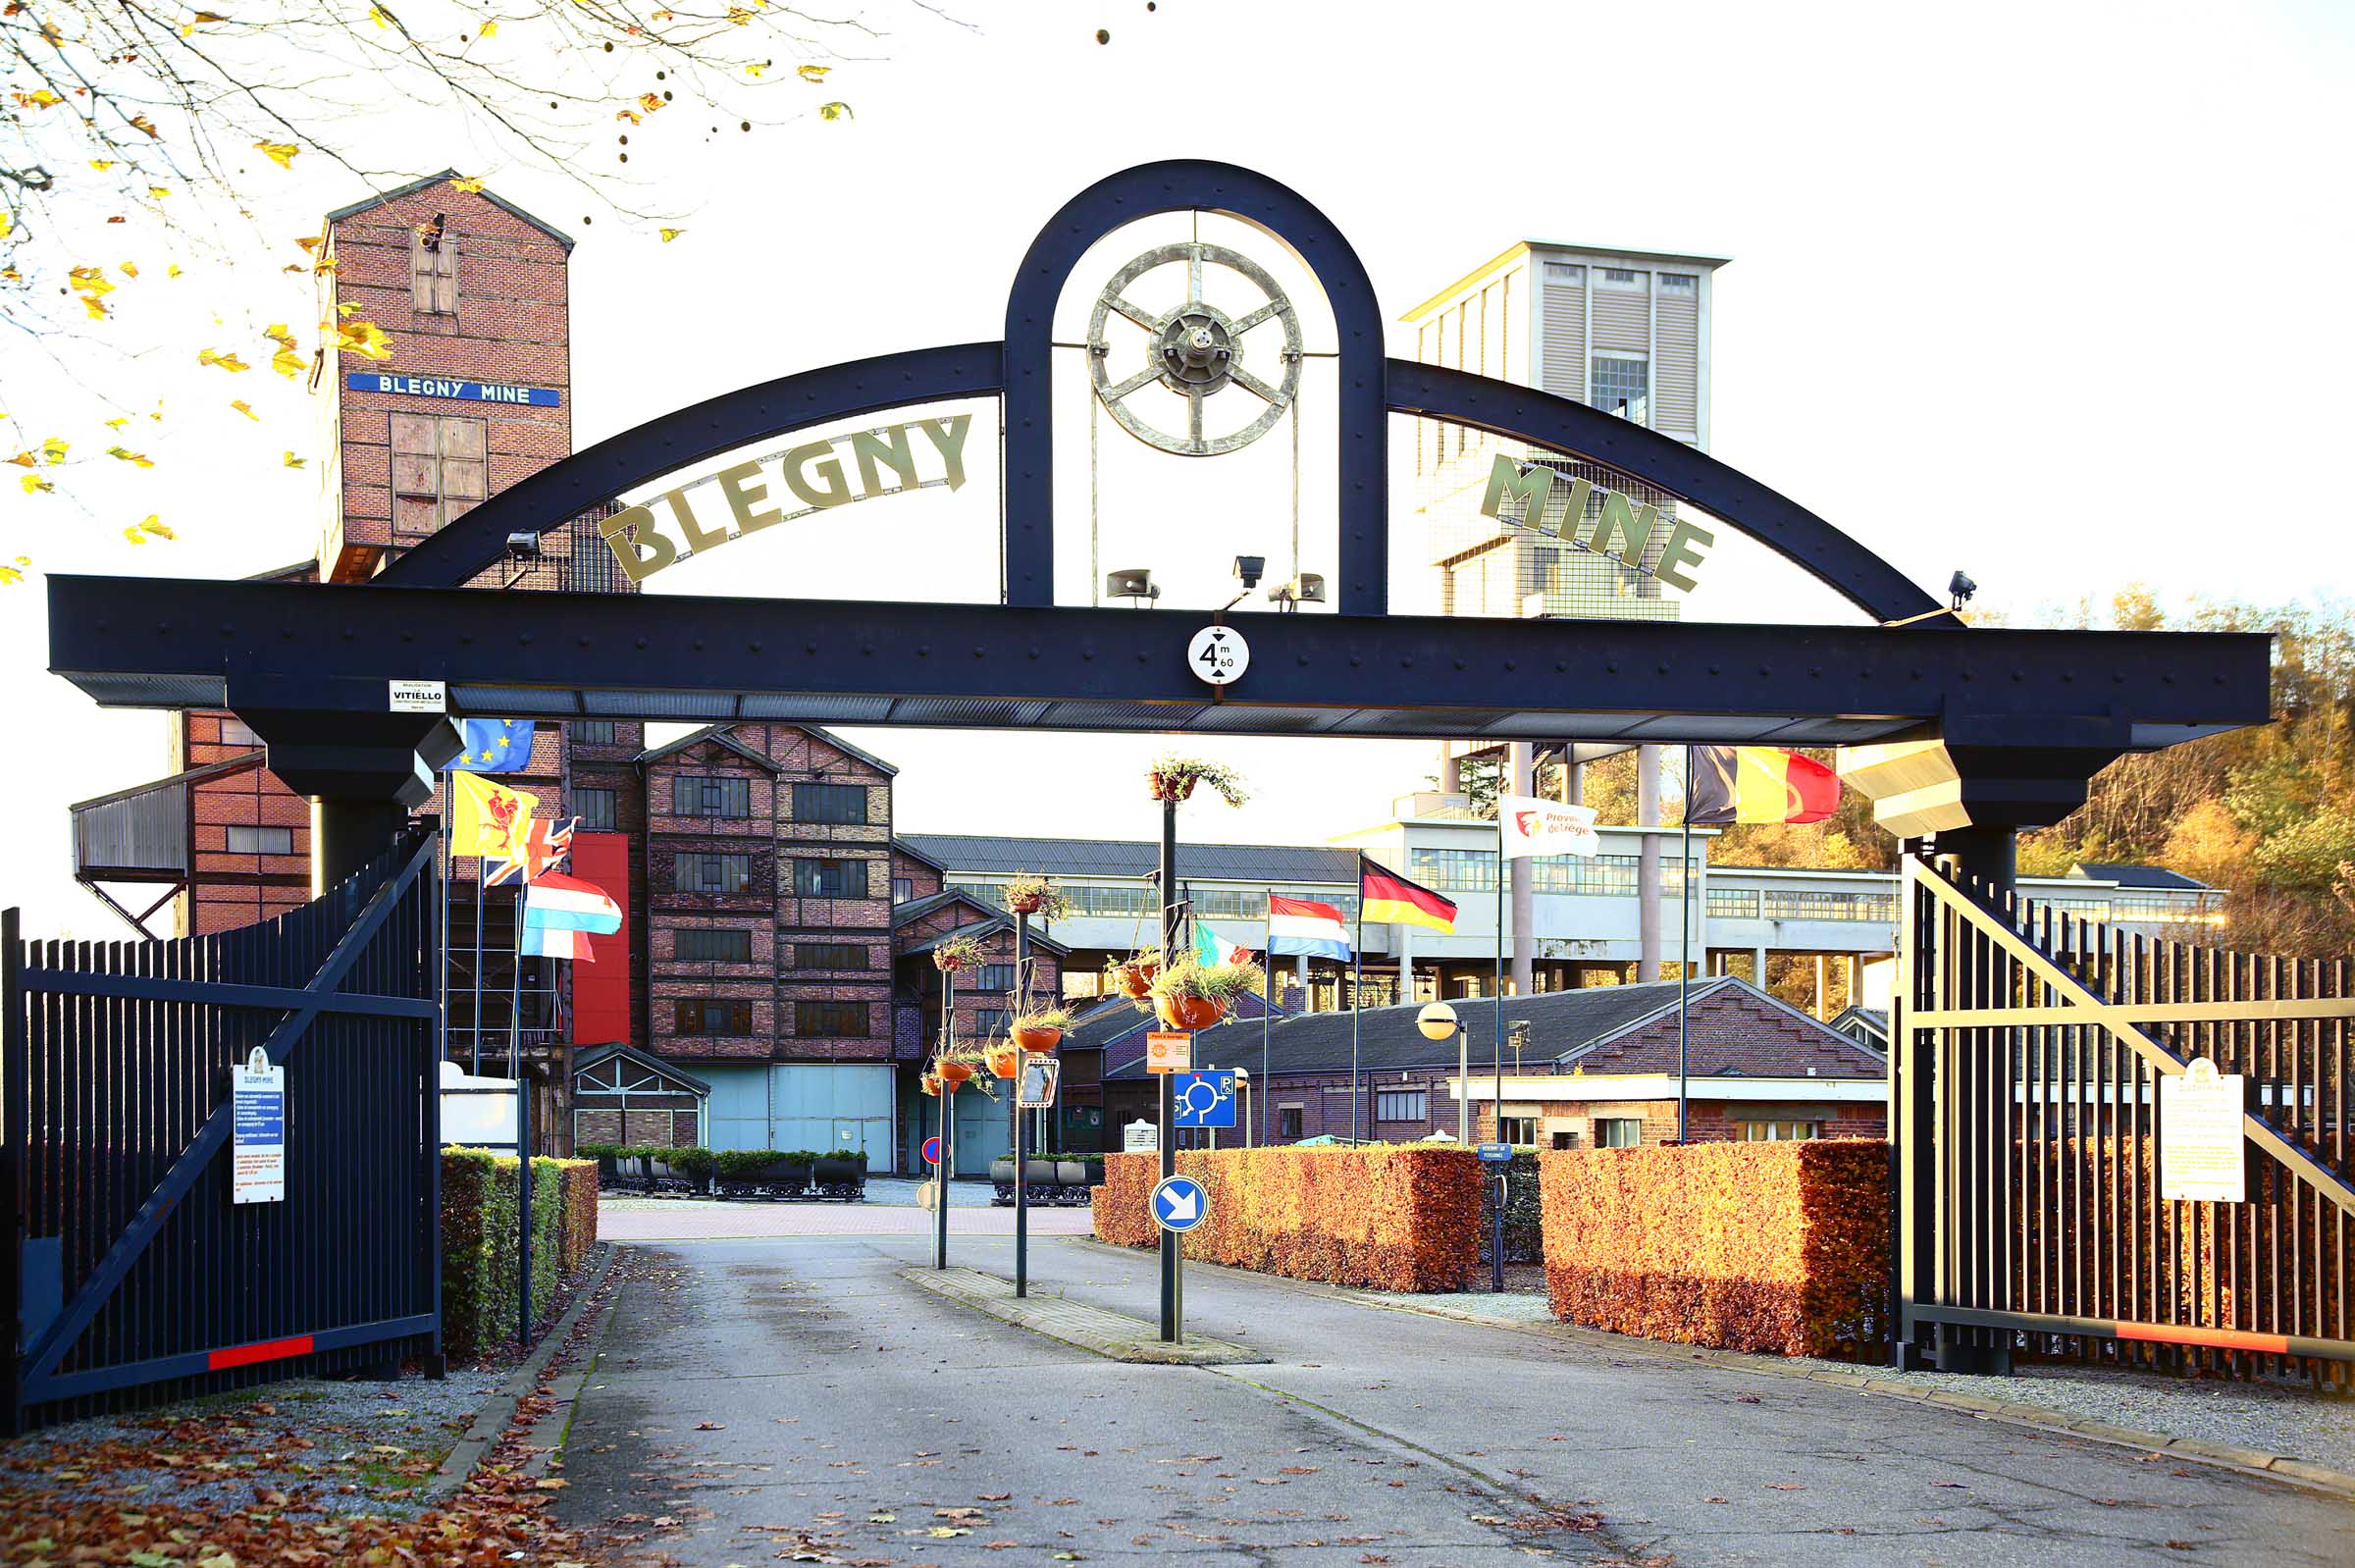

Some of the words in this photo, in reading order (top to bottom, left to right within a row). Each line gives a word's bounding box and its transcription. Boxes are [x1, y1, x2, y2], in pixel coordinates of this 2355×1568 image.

[379, 376, 464, 397] BLEGNY
[481, 385, 530, 403] MINE
[598, 413, 972, 584] BLEGNY
[1480, 453, 1714, 594] MINE
[1199, 643, 1218, 667] 4
[1220, 658, 1233, 667] 60
[1223, 1077, 1231, 1089] P
